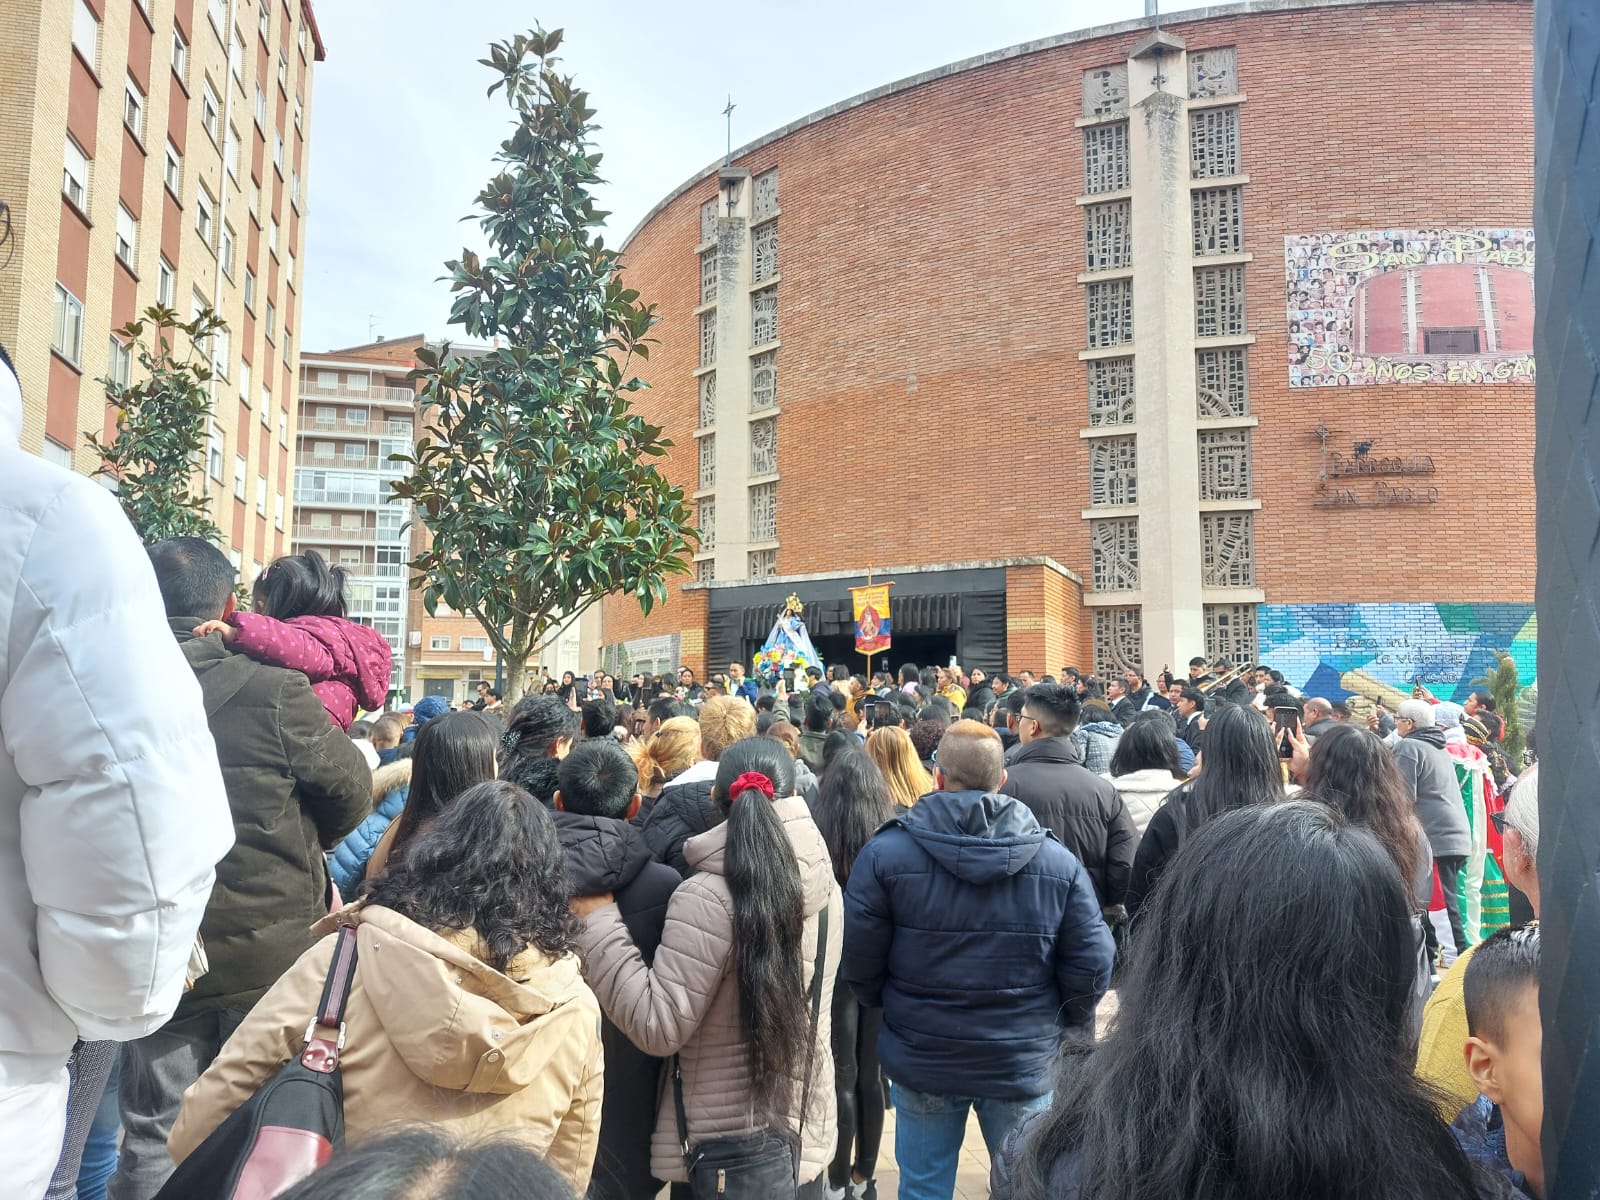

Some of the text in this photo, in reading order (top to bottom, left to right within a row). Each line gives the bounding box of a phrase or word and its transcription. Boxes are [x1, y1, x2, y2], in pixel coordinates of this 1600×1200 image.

[1327, 239, 1422, 273] SAN
[1305, 347, 1353, 373] 50
[1364, 355, 1431, 381] AÑOS
[1447, 365, 1478, 383] EN
[1335, 634, 1379, 649] Para
[1375, 651, 1394, 665] la
[1396, 646, 1433, 665] vida
[1404, 670, 1458, 684] Cristo
